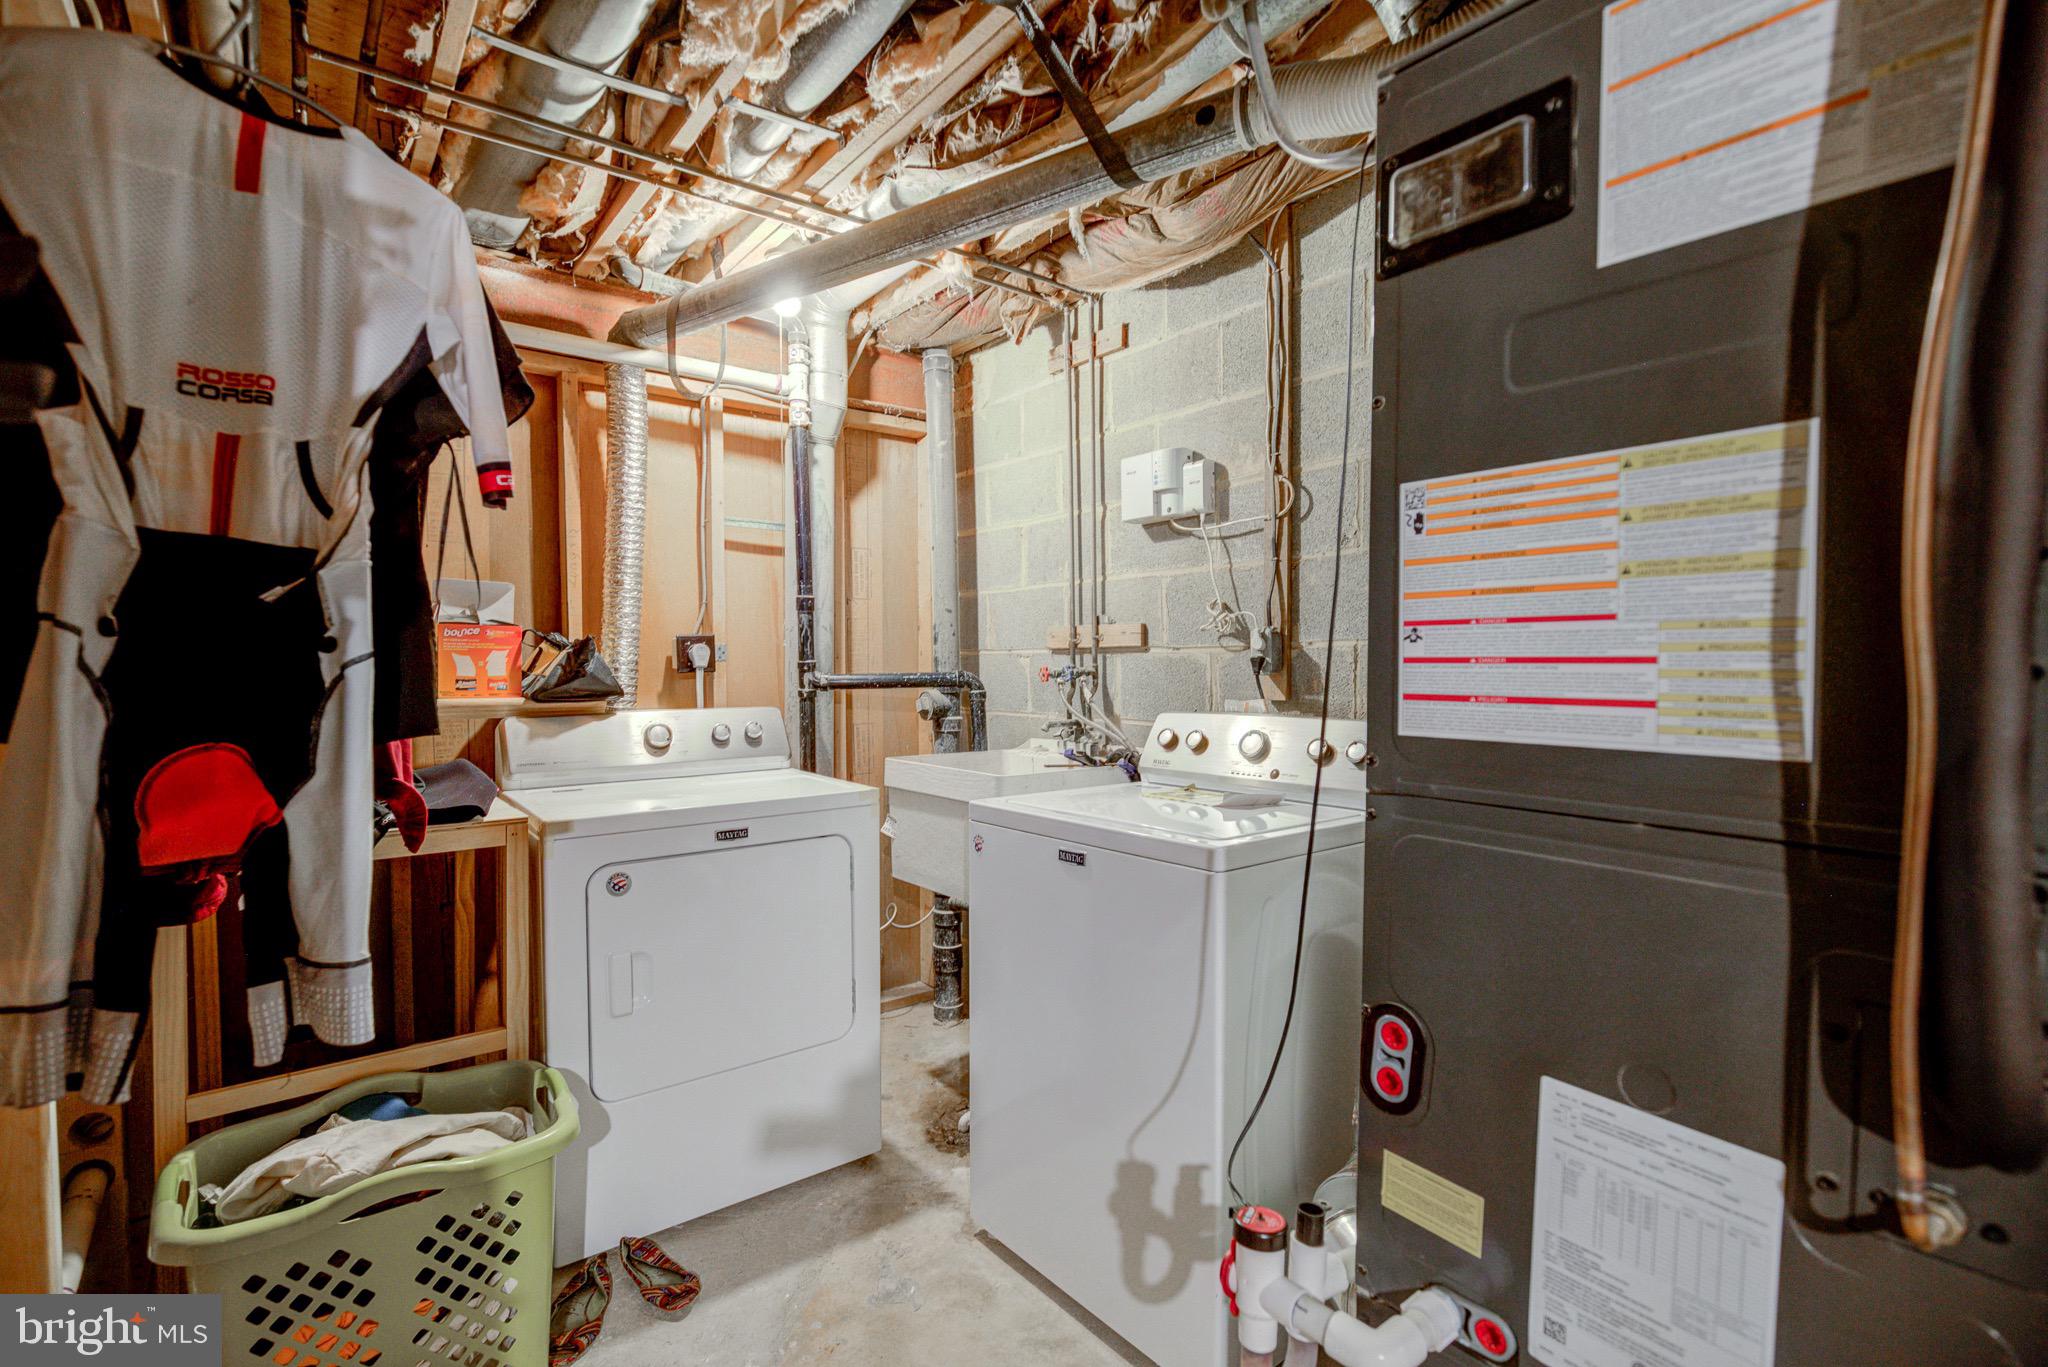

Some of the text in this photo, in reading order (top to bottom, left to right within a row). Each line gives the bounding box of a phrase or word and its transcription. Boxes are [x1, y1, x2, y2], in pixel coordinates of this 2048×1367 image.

[177, 362, 275, 391] ROSSO
[177, 379, 274, 406] CORSA
[443, 627, 480, 637] bounce
[718, 830, 747, 840] MAYTAG
